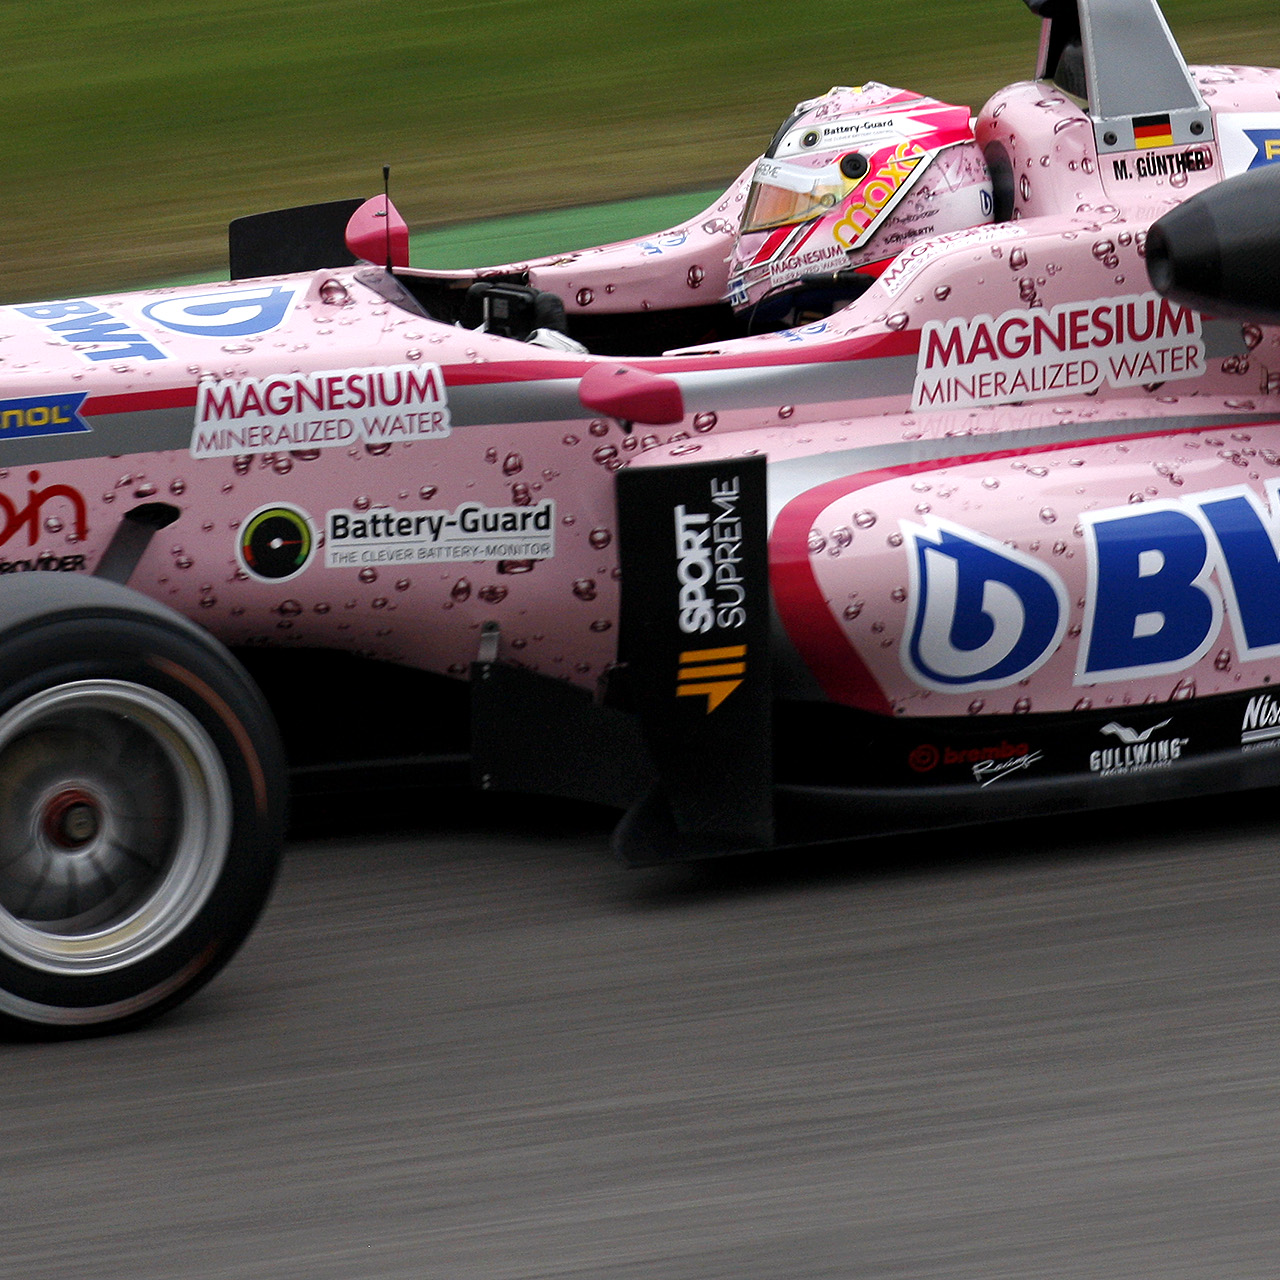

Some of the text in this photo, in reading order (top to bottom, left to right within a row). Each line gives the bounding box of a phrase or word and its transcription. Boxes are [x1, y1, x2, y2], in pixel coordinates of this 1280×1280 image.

[824, 120, 893, 136] Battery-Guard
[1113, 151, 1206, 180] M. GÜNTHER
[771, 244, 844, 275] MAGNESIUM
[13, 300, 168, 361] BWT
[925, 298, 1195, 369] MAGNESIUM
[201, 368, 440, 422] MAGNESIUM
[919, 346, 1199, 407] MINERALIZED WATER
[196, 411, 446, 453] MINERALIZED WATER
[331, 504, 551, 541] Battery-Guard
[332, 551, 357, 564] THE
[361, 548, 413, 563] CLEVER
[674, 504, 715, 634] SPORT
[710, 476, 747, 629] SUPREME
[944, 741, 1029, 765] brembo
[1090, 738, 1181, 771] GULLWING
